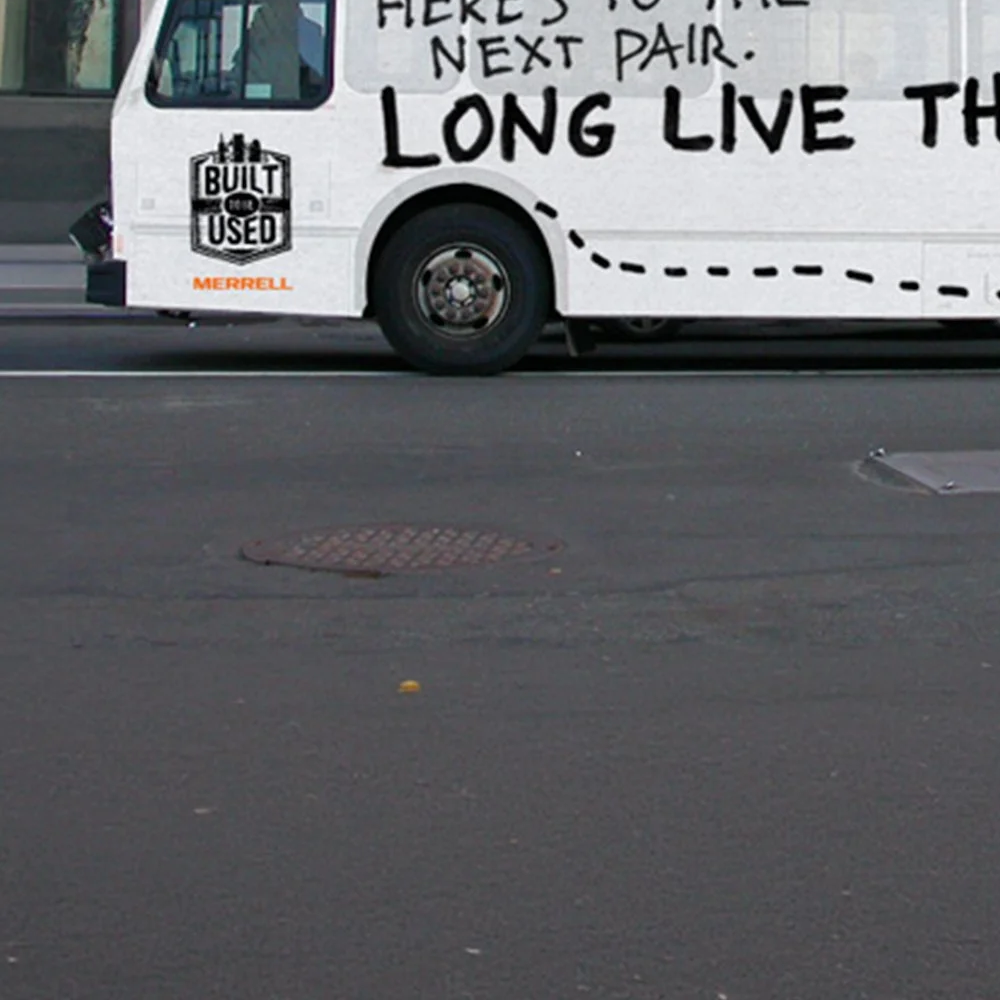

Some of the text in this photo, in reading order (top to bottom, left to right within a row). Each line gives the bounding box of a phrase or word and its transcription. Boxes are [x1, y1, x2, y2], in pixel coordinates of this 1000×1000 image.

[430, 22, 755, 81] NEXT PAIR.
[380, 85, 616, 168] LONG
[663, 82, 855, 155] LIVE
[204, 164, 279, 196] BUILT
[207, 214, 276, 246] USED
[193, 276, 293, 291] MERRELL
